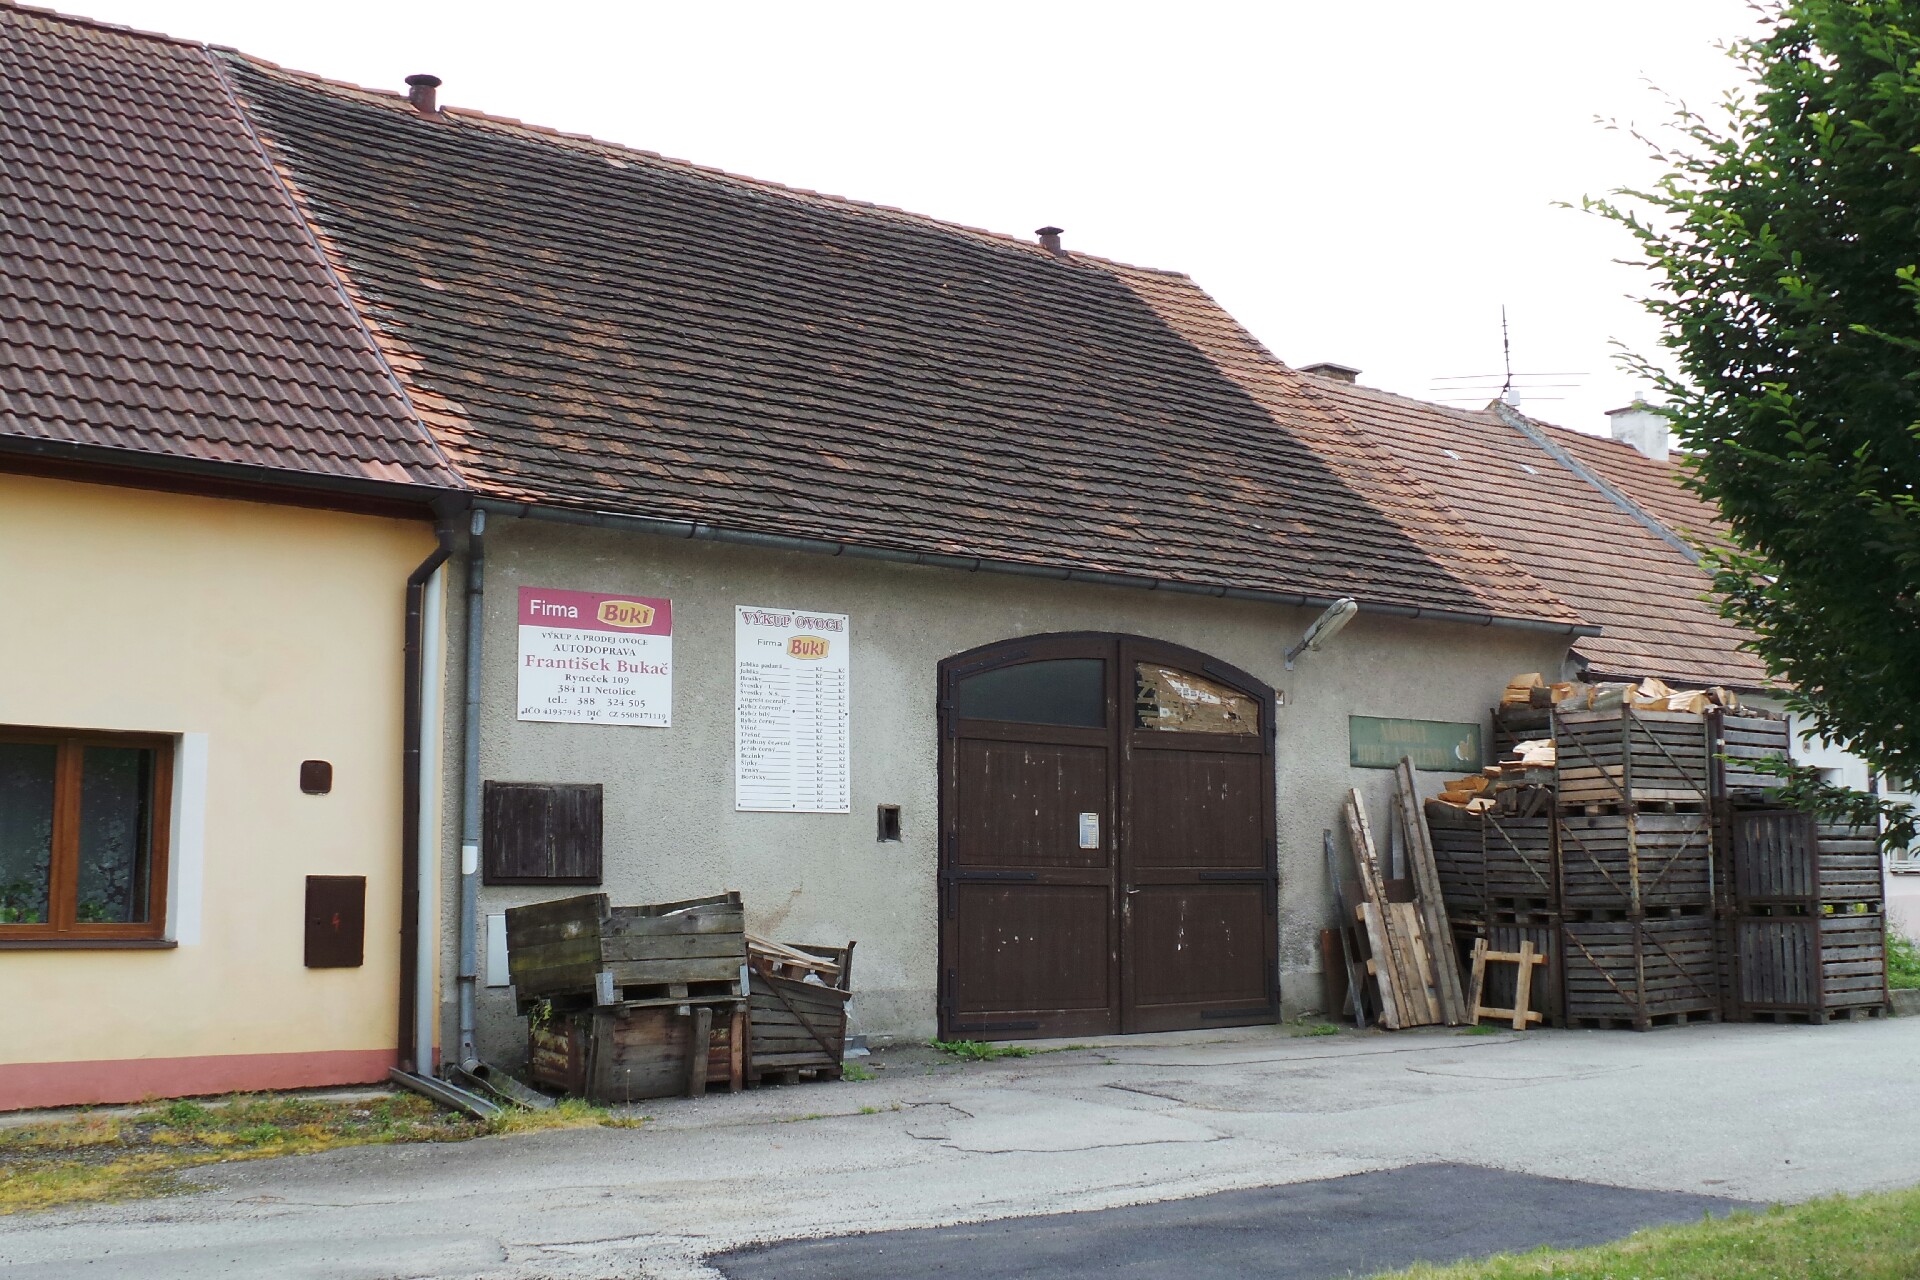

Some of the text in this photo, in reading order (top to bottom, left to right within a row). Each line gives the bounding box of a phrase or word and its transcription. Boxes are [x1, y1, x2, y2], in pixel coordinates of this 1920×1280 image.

[530, 600, 650, 624] Firma Buki
[742, 610, 843, 632] VÝKUP OVOCE
[542, 631, 571, 640] VÝKUP
[583, 635, 616, 644] PRODEJ
[553, 644, 636, 656] AUTODOPRAVA
[791, 640, 825, 655] Buki
[525, 654, 668, 675] František Bukač
[565, 674, 608, 683] Ryneček
[558, 685, 575, 694] 384
[595, 687, 636, 695] Netolice
[628, 700, 645, 708] 505
